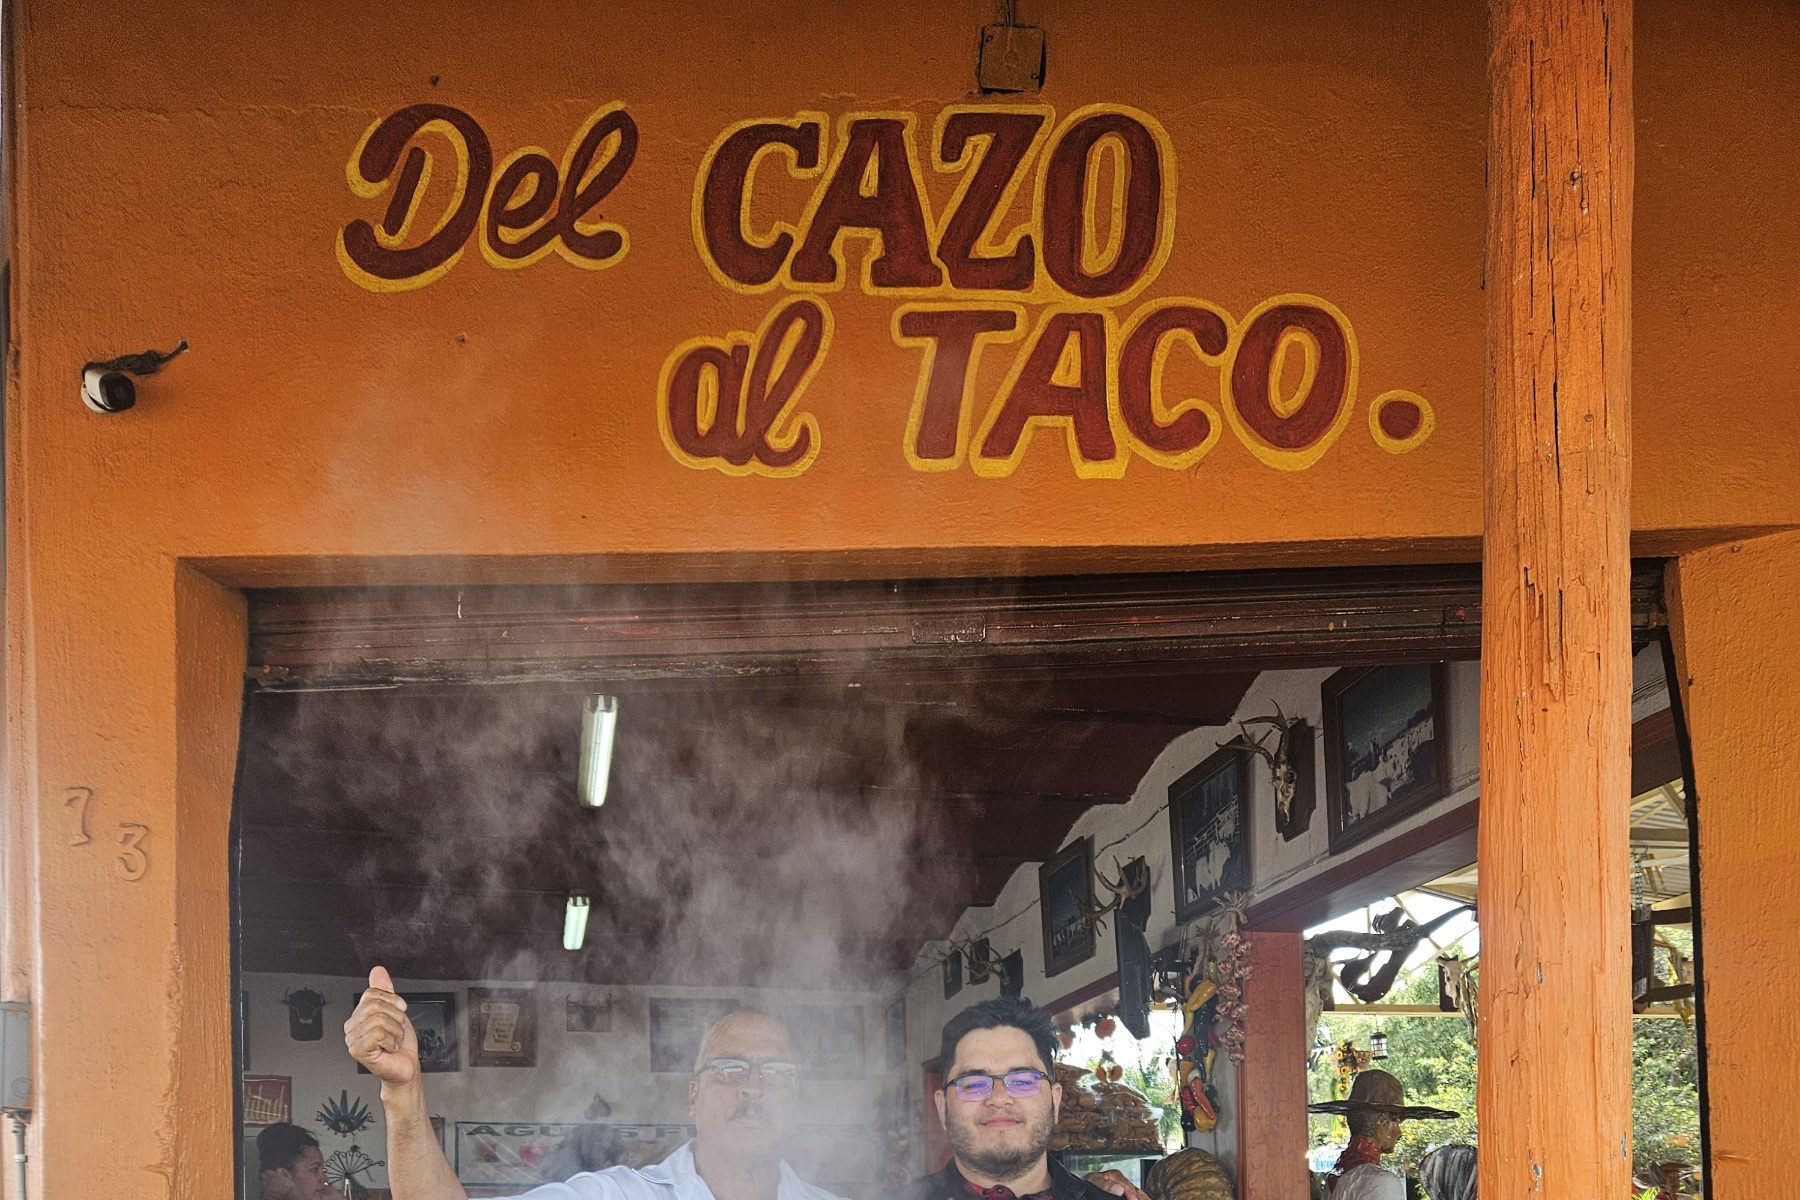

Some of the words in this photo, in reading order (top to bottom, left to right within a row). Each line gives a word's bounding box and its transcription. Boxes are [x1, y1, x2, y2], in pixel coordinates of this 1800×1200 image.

[336, 100, 640, 294] Del
[692, 102, 1179, 303] CAZO
[658, 295, 835, 477] al
[892, 292, 1435, 479] TACO.
[466, 1124, 641, 1138] AGUS
